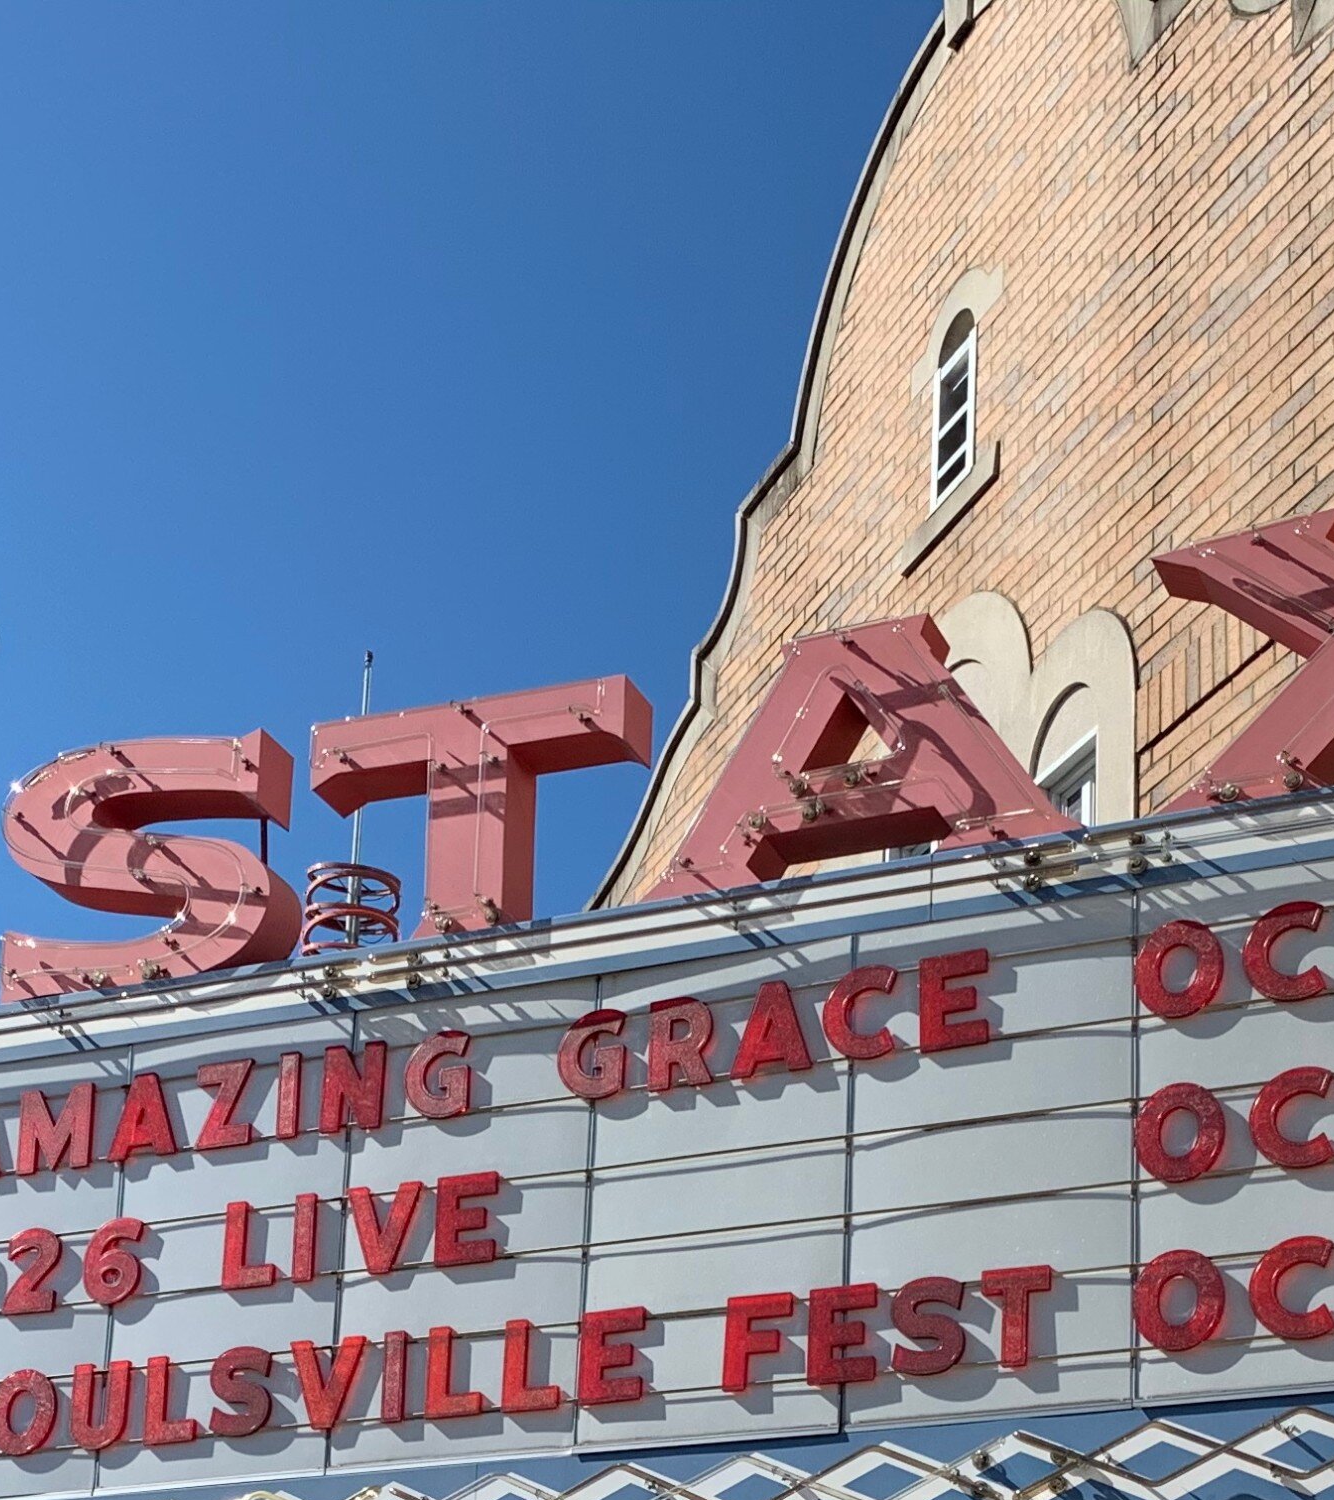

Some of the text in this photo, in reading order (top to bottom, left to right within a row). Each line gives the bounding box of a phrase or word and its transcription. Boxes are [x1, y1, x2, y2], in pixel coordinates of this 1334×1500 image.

[557, 948, 990, 1100] GRACE
[220, 1170, 502, 1291] LIVE
[721, 1264, 1053, 1392] FEST
